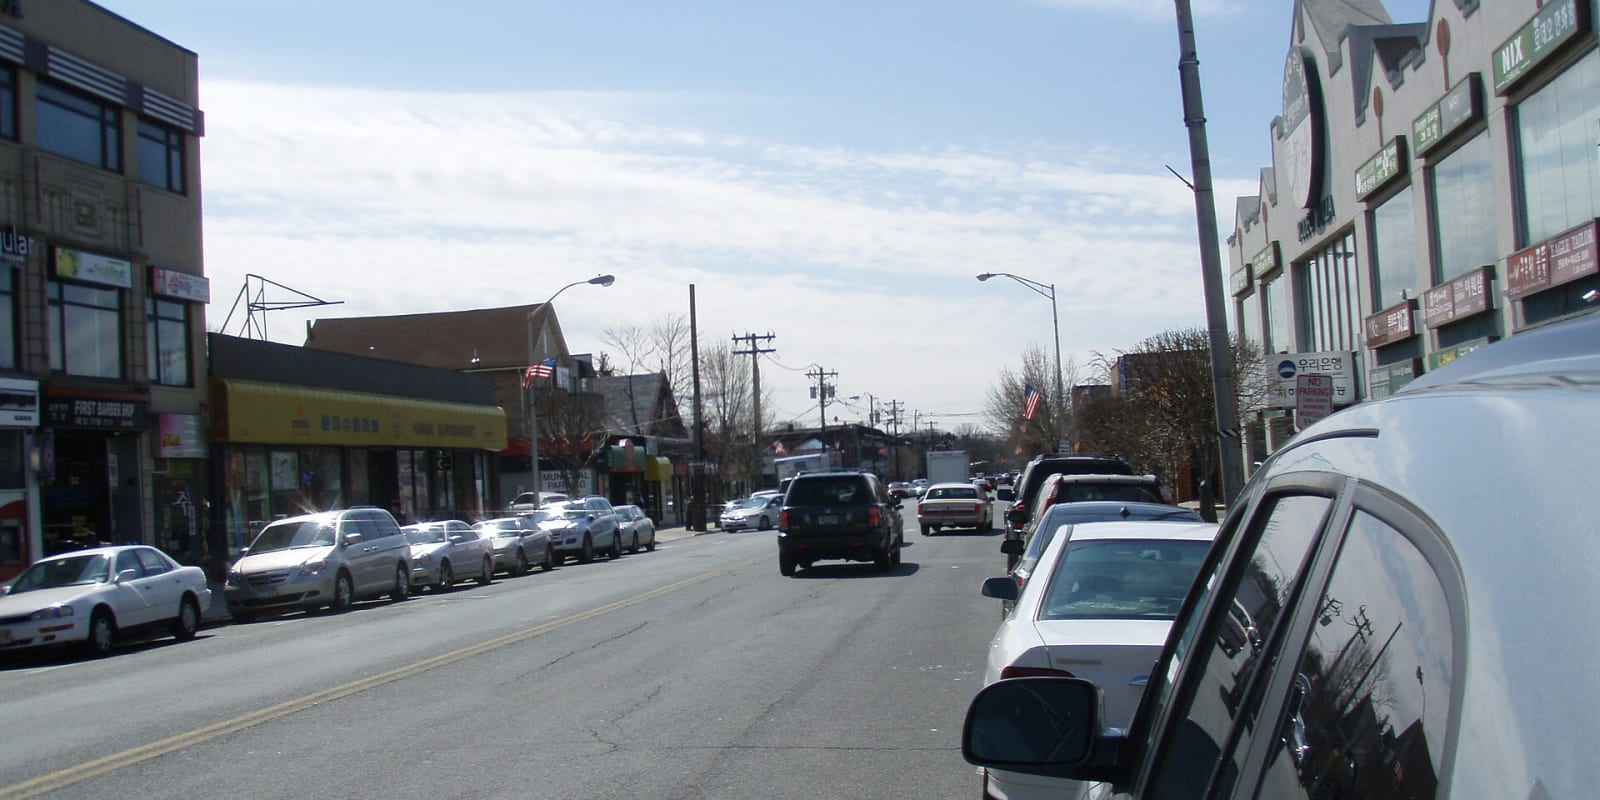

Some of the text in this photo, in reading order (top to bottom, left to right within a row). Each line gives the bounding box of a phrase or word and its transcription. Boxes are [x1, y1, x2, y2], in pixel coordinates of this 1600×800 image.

[1502, 36, 1523, 74] NIX
[0, 225, 33, 255] ular
[1550, 229, 1593, 258] EAGLE TAILOR
[1298, 357, 1343, 373] 우리은행
[1308, 378, 1321, 387] NO
[1300, 387, 1329, 397] PARKING
[75, 400, 96, 416] FIRST
[97, 401, 120, 417] BARBER
[121, 403, 135, 418] SHOP
[543, 471, 590, 481] MUNAL
[547, 480, 586, 489] PARG
